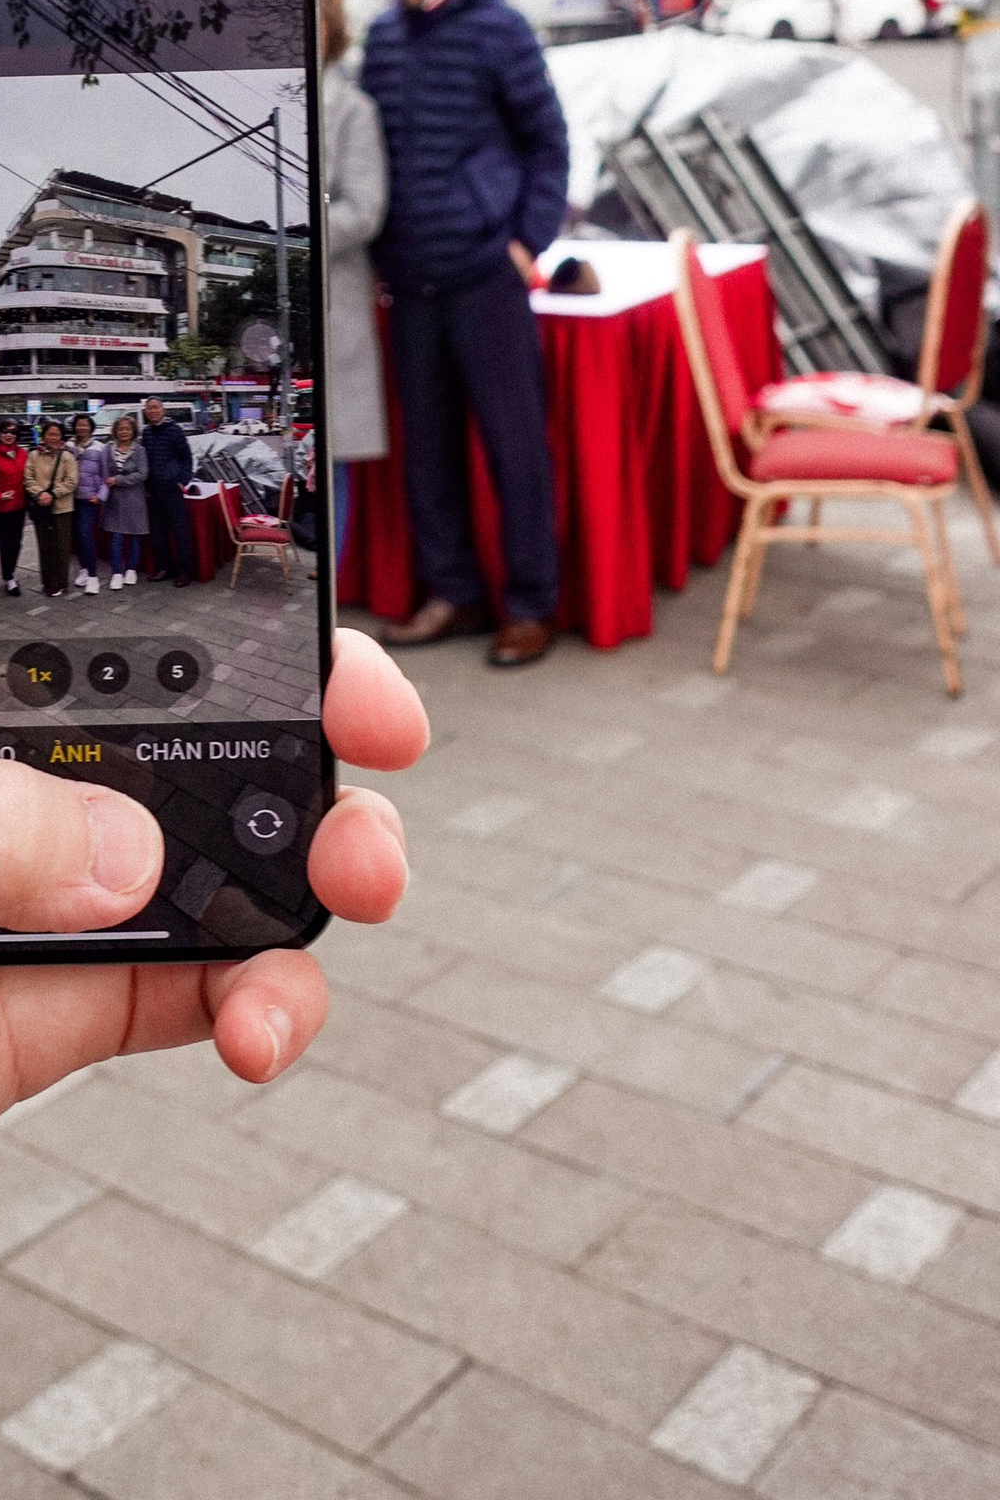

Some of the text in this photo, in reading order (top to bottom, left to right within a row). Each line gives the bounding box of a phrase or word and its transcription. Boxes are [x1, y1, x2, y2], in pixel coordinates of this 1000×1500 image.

[27, 668, 52, 683] 1x
[102, 667, 114, 680] 2
[172, 665, 184, 678] 5
[50, 739, 101, 763] ẢNH
[136, 738, 271, 761] CHÂN DUNG
